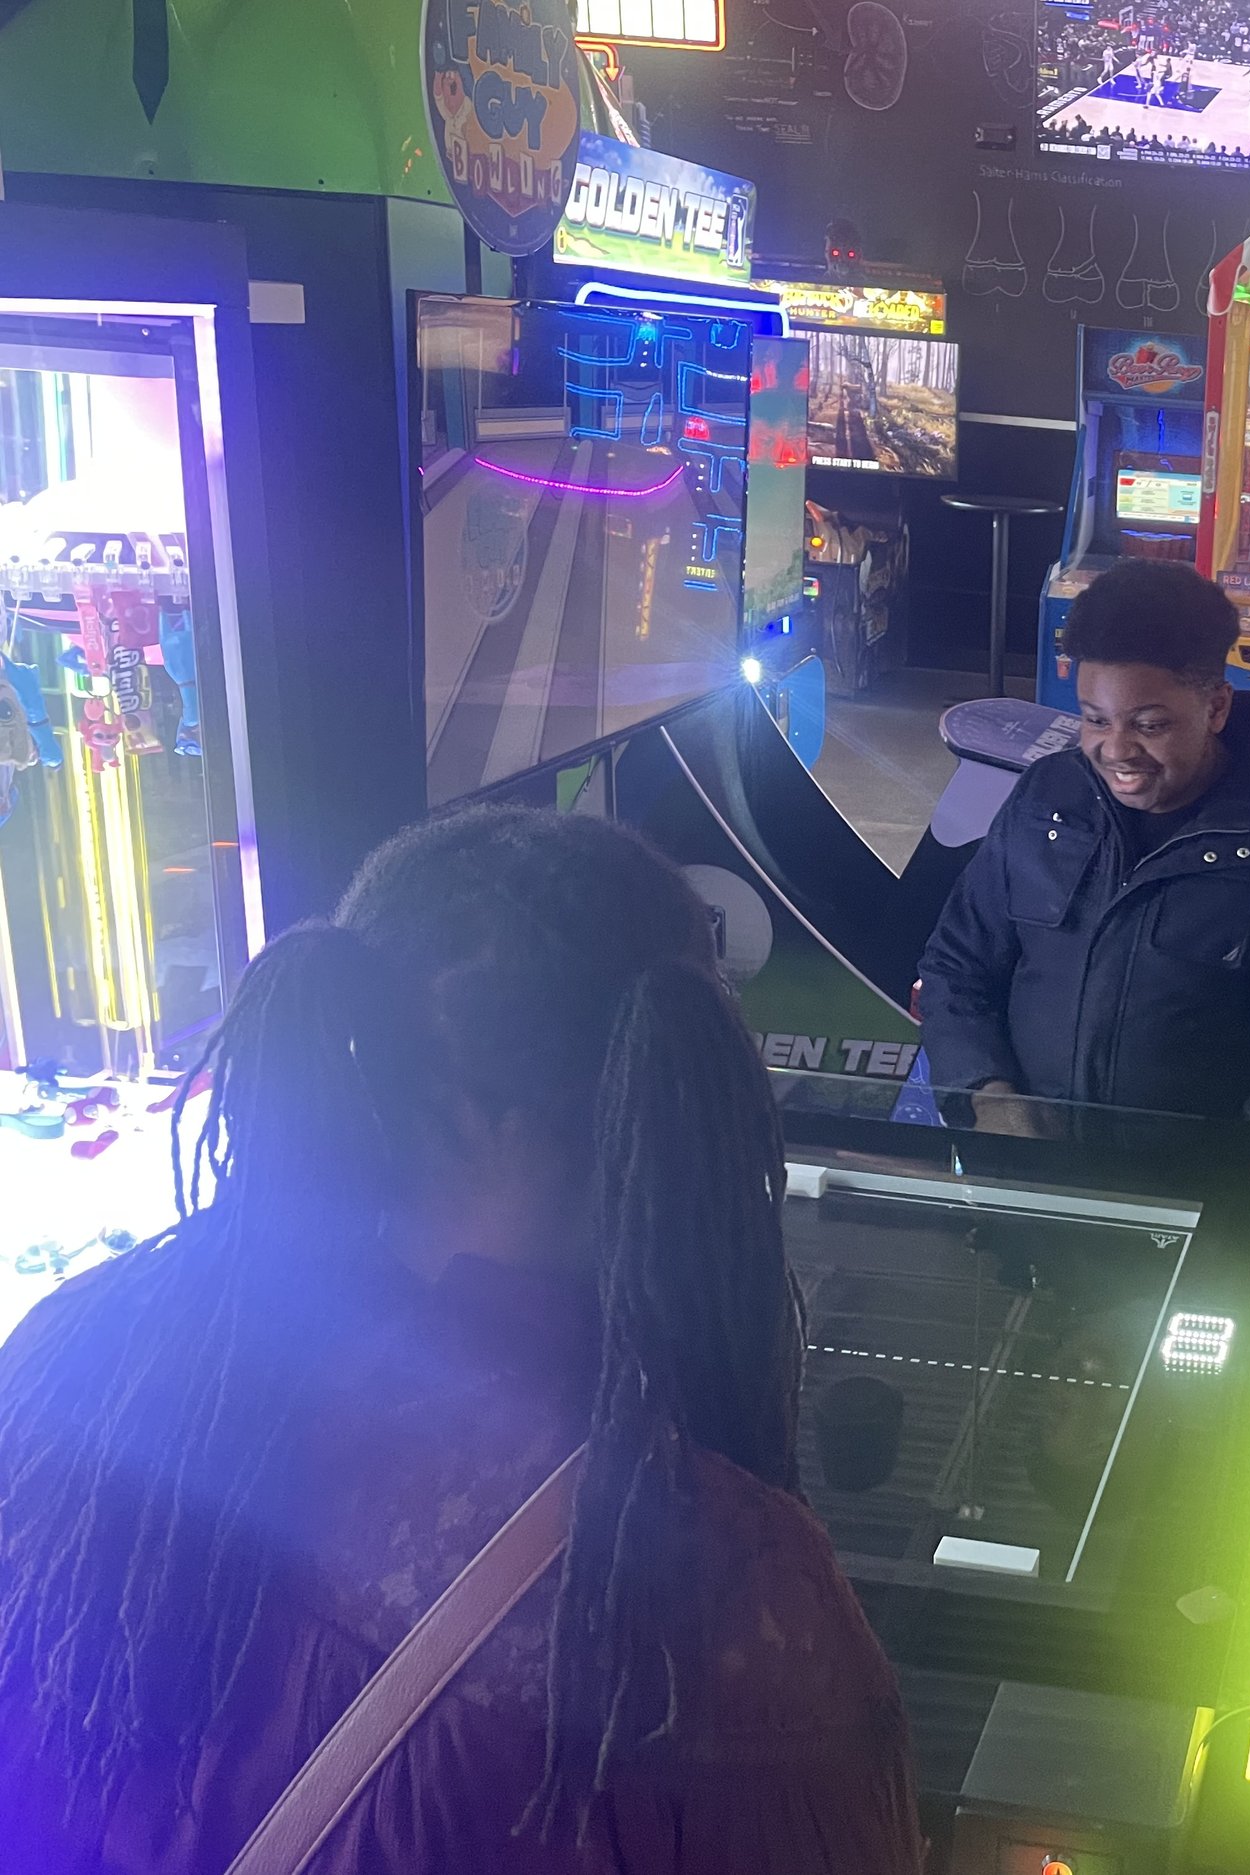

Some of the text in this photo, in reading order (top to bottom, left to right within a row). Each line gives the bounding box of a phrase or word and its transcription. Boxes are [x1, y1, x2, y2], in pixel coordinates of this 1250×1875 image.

[473, 70, 550, 151] GUY
[450, 136, 563, 202] BOWLING
[565, 162, 680, 248] GOLDEN
[683, 191, 728, 252] TEE
[789, 306, 837, 319] HUNTER
[1223, 575, 1242, 586] RED
